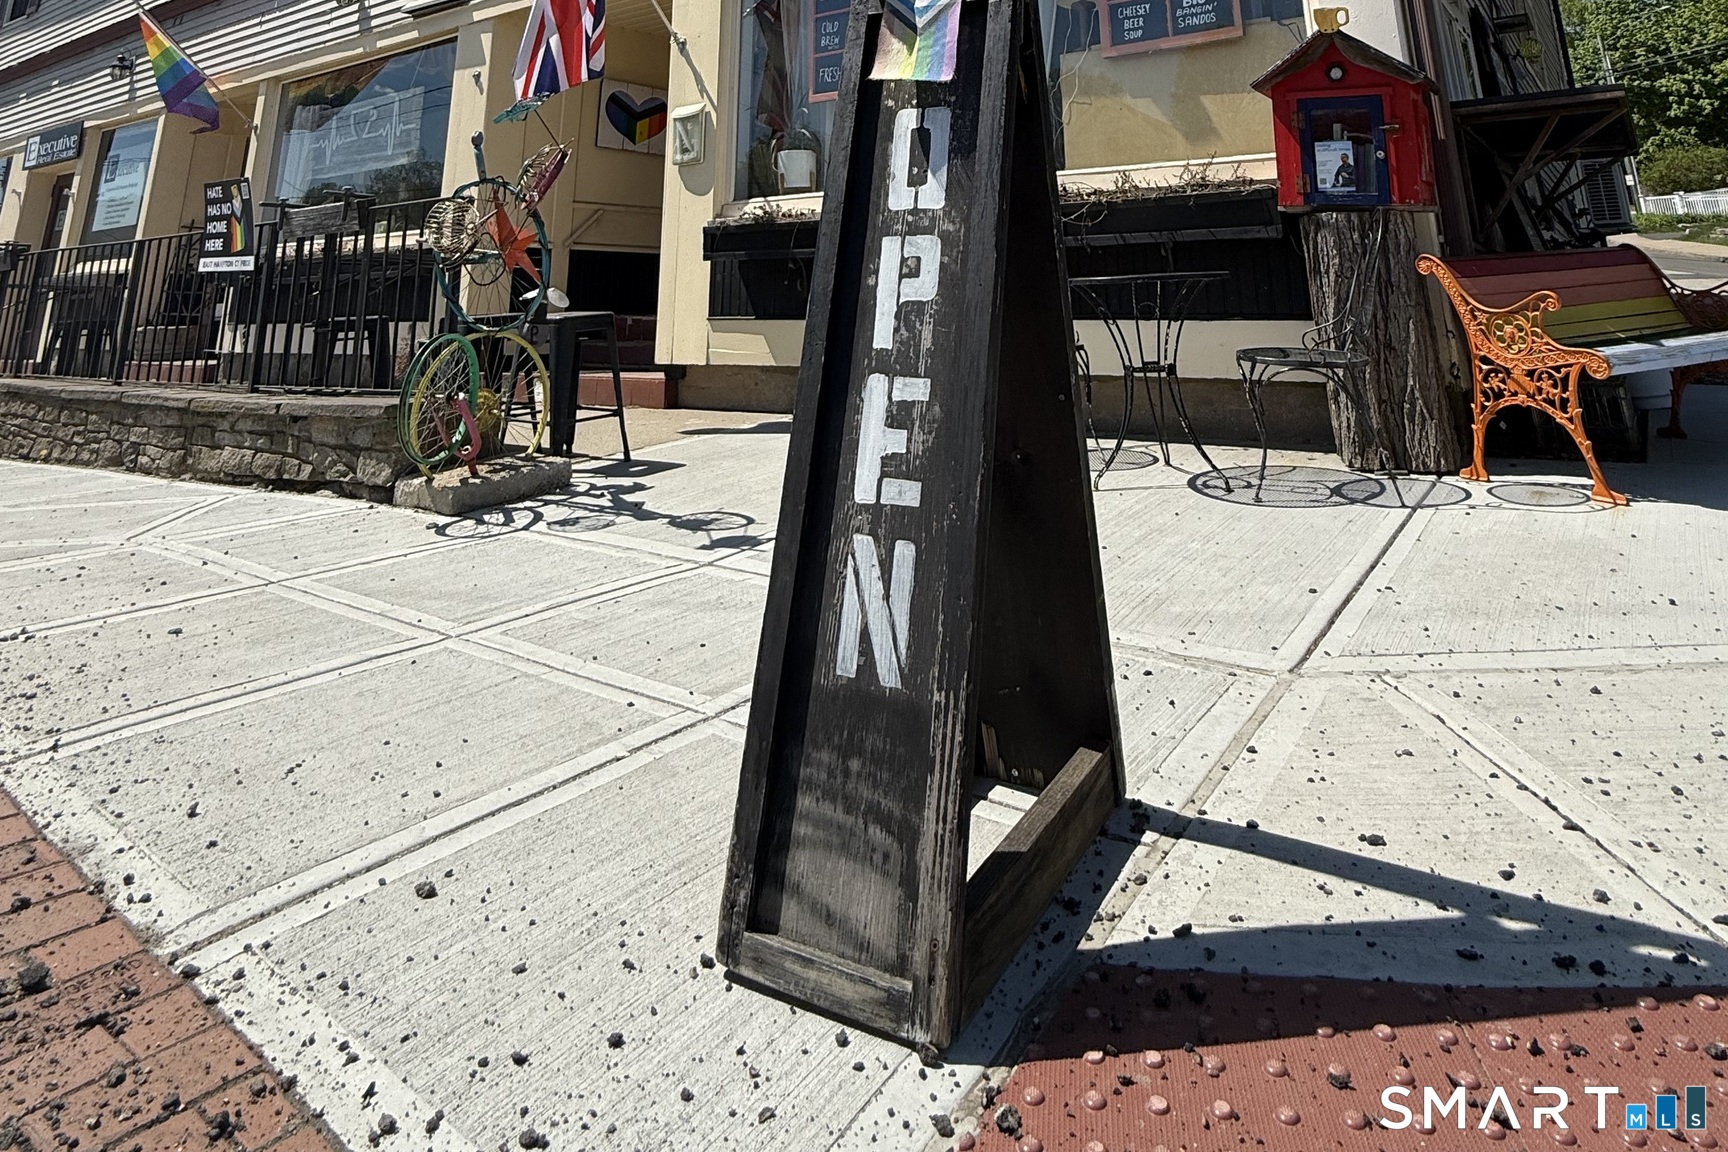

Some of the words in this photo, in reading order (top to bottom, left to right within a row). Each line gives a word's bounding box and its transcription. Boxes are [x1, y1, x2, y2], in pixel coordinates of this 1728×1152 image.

[1117, 2, 1151, 19] CHEESEY
[1176, 1, 1217, 17] BANGIN'
[1123, 17, 1144, 30] BEER
[1177, 12, 1216, 28] SANDOS
[820, 34, 840, 47] BREW
[1124, 29, 1143, 41] SOUP
[26, 134, 78, 163] Executive
[36, 153, 52, 164] Real
[206, 186, 223, 199] HATE
[207, 204, 220, 216] HAS
[221, 202, 232, 215] NO
[206, 221, 227, 234] HOME
[204, 238, 224, 251] HERE
[836, 106, 951, 689] OPEN
